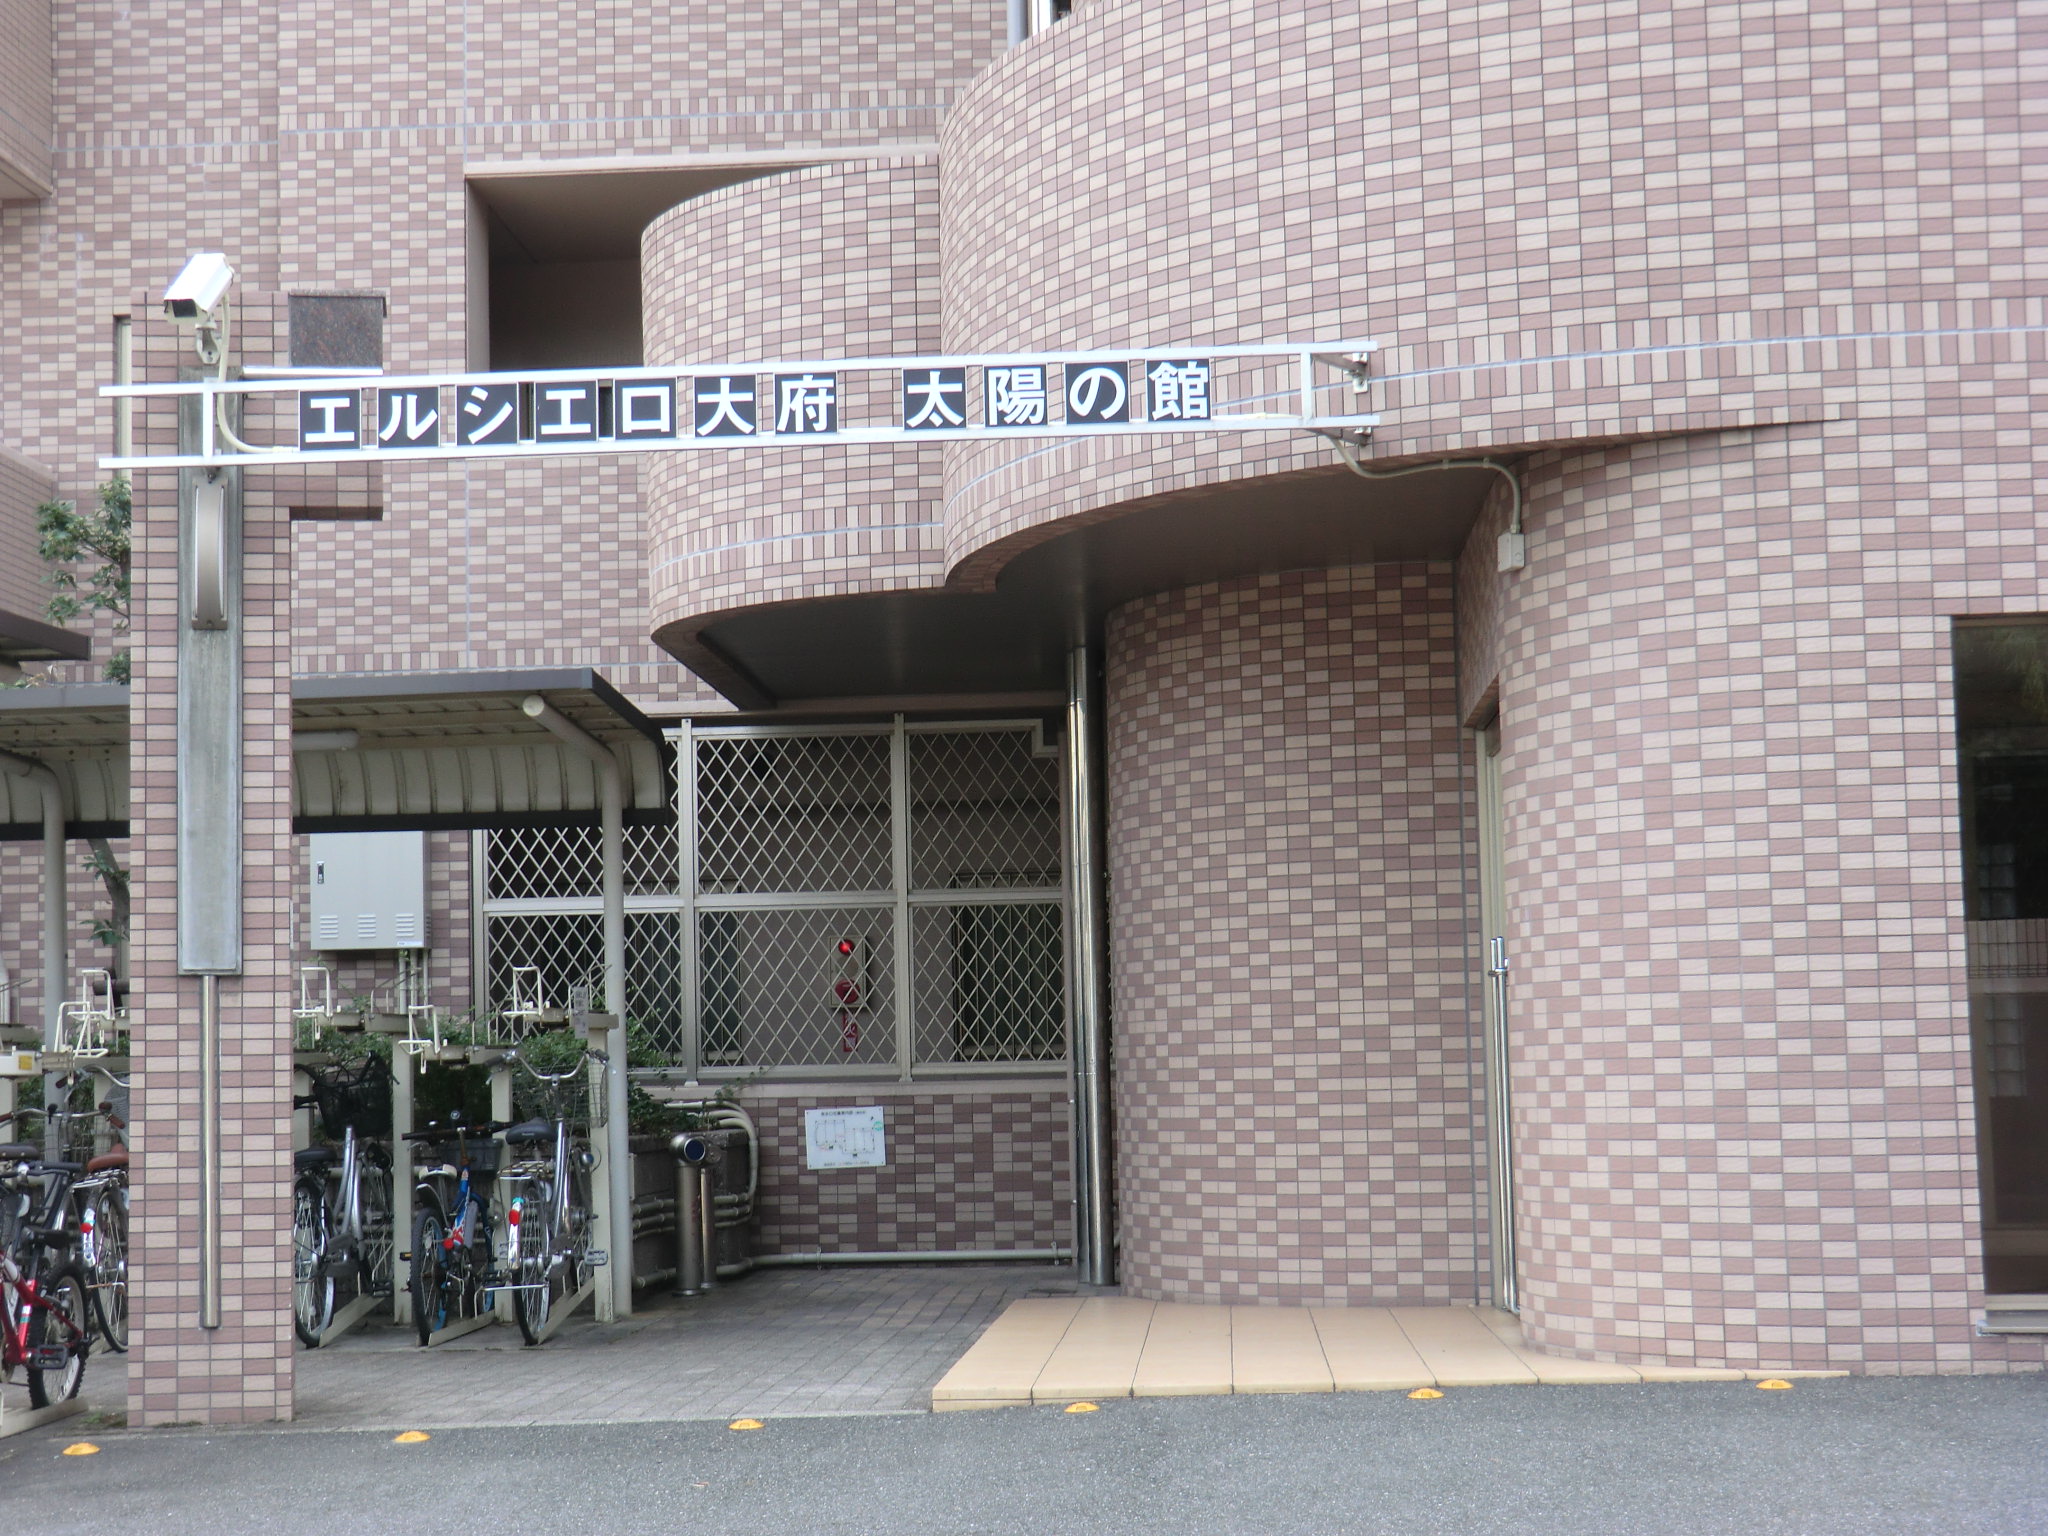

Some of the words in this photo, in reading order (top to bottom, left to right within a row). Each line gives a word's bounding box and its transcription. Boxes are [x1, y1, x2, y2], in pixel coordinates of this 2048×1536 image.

[304, 377, 833, 443] エルシエロ大府
[906, 360, 1208, 429] 太陽の館
